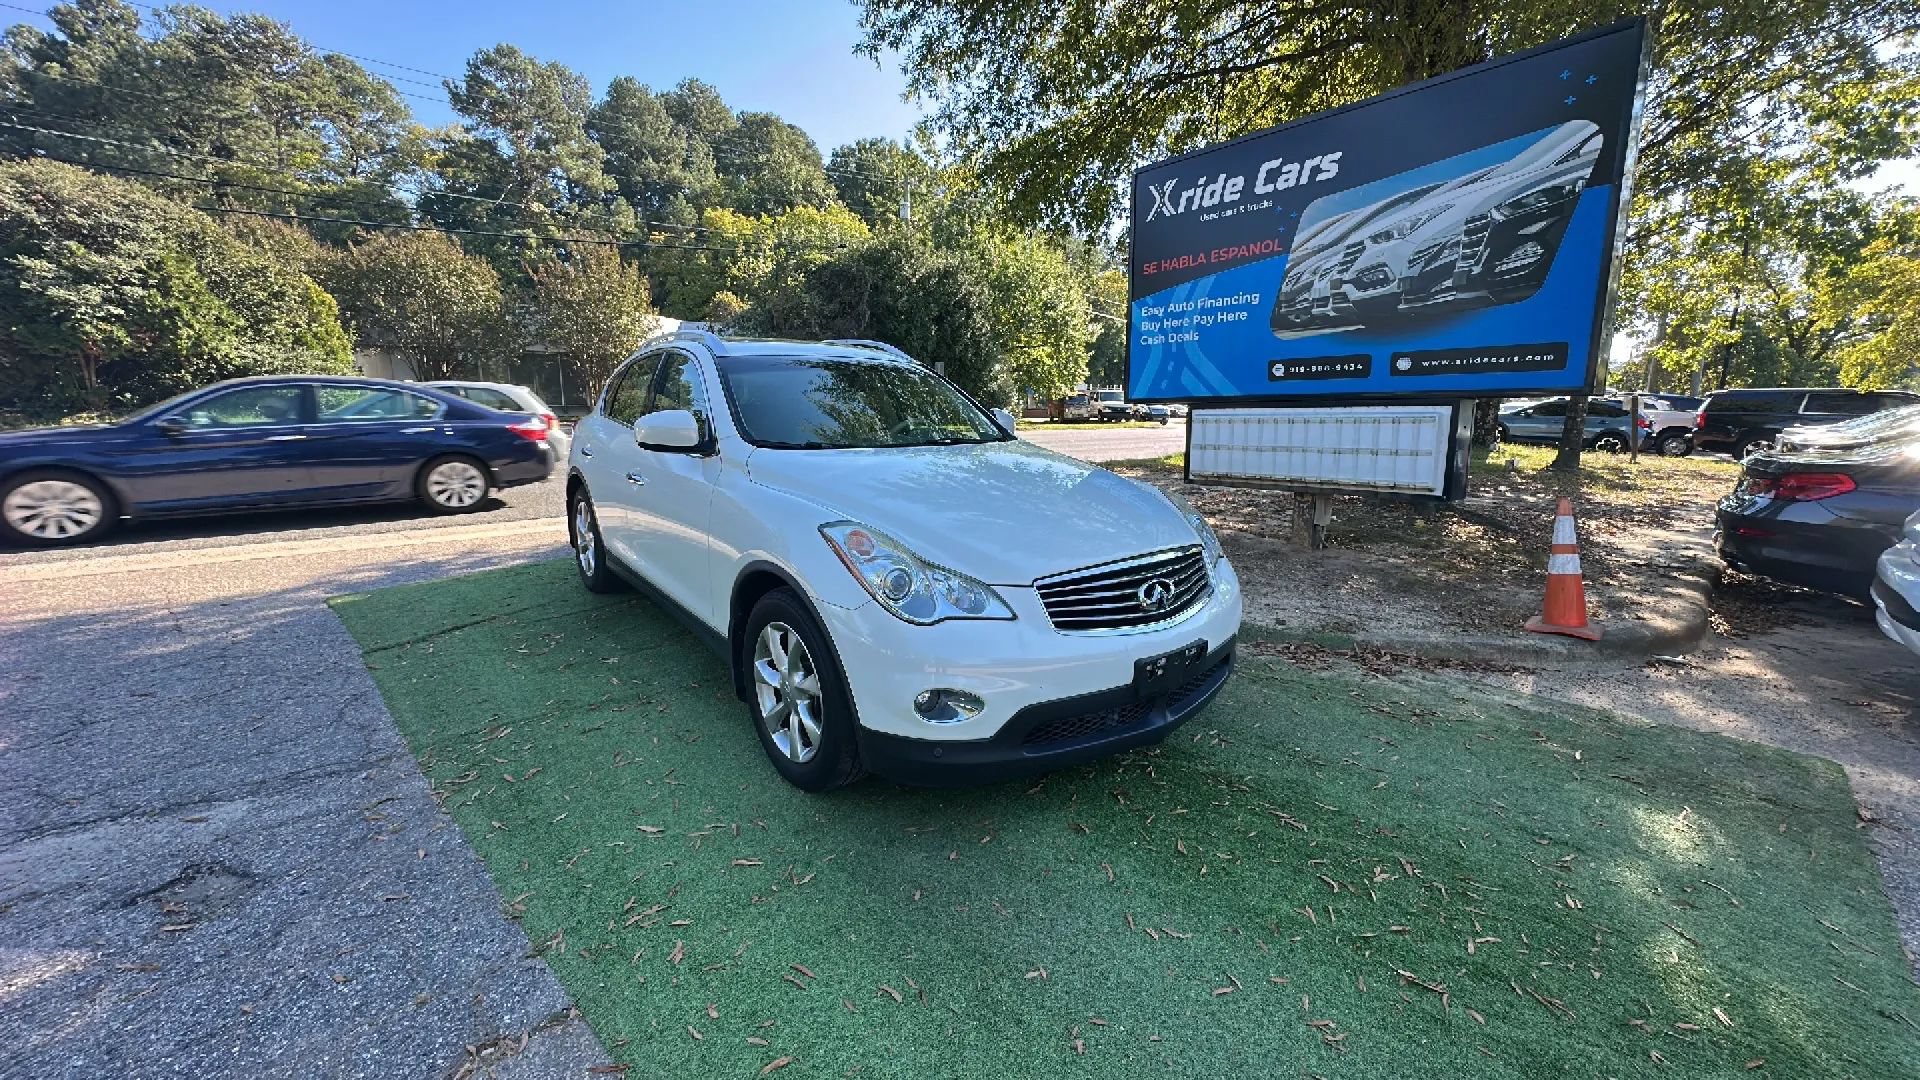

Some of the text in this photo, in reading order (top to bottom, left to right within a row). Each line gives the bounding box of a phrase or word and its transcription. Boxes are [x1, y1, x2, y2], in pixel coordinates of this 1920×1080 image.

[1145, 151, 1343, 223] Xride Cars
[1200, 211, 1219, 222] Used
[1247, 200, 1273, 212] trucks
[1143, 261, 1158, 275] SE
[1161, 253, 1206, 272] HABLA
[1141, 292, 1260, 317] Easy Auto Financing
[1141, 310, 1248, 332] Buy Here Pay Here
[1140, 331, 1200, 346] Cash Deals
